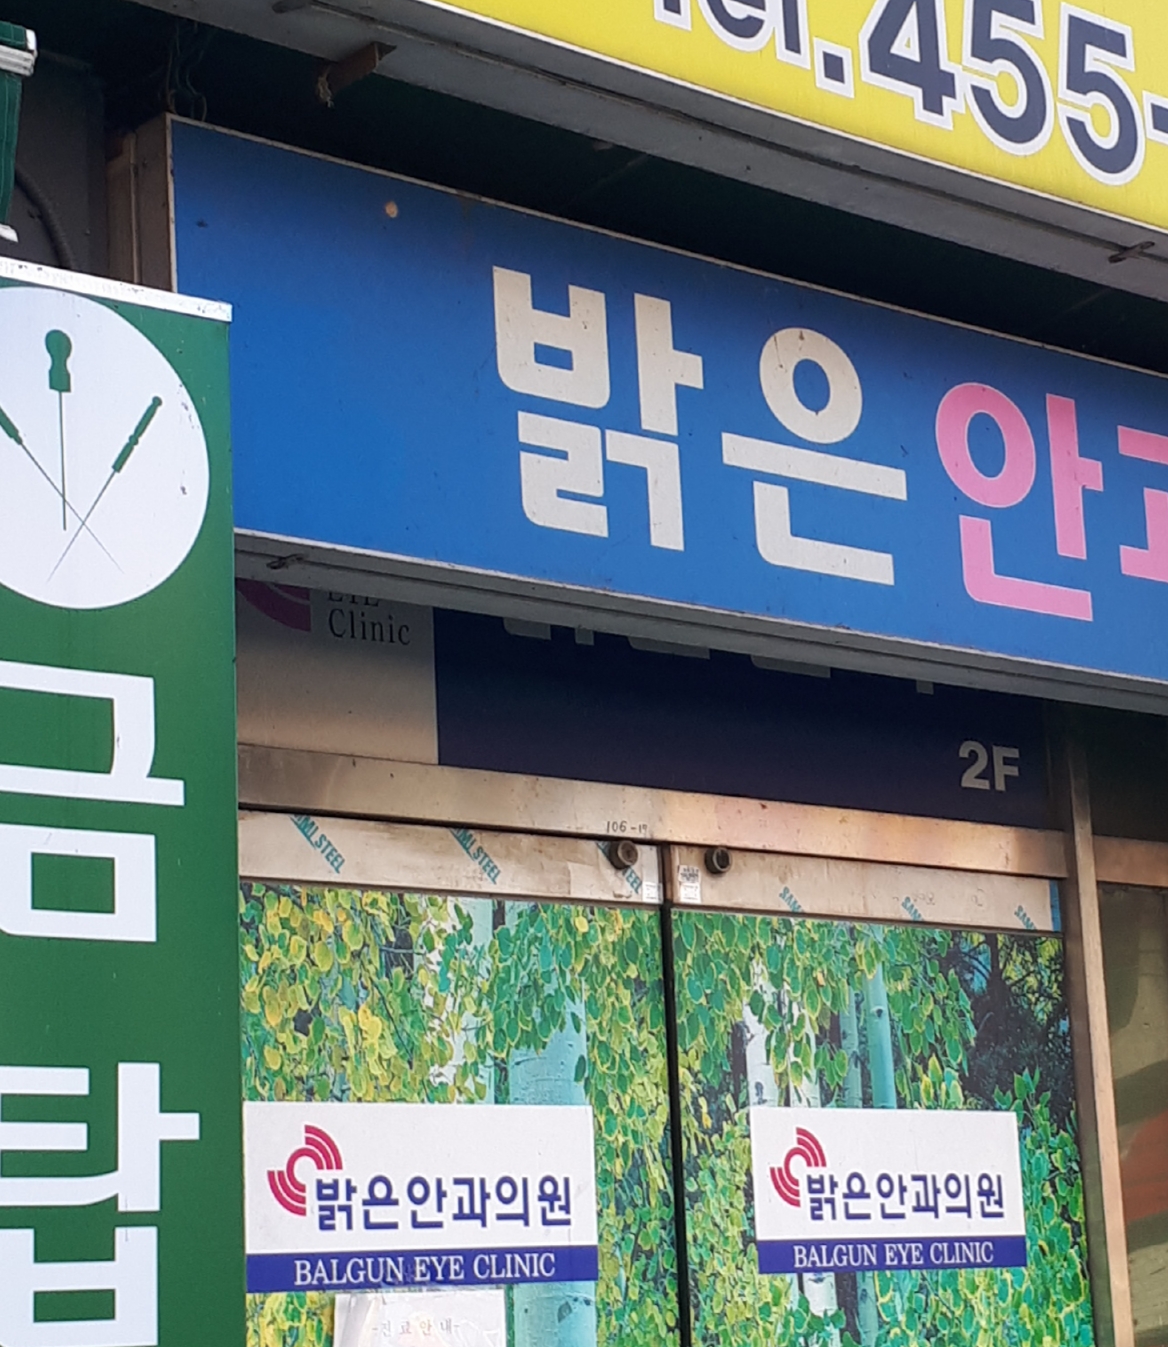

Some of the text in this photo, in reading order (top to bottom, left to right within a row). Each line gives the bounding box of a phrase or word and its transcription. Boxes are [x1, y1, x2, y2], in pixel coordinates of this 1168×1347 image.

[328, 608, 411, 647] Clinic
[958, 740, 1021, 793] 2F
[315, 1174, 572, 1232] 밝은안과의원
[806, 1171, 1005, 1221] 밝은안과의원
[293, 1252, 557, 1287] BALGUN EYE CLINIC
[792, 1241, 995, 1268] BALGUN EYE CLINIC
